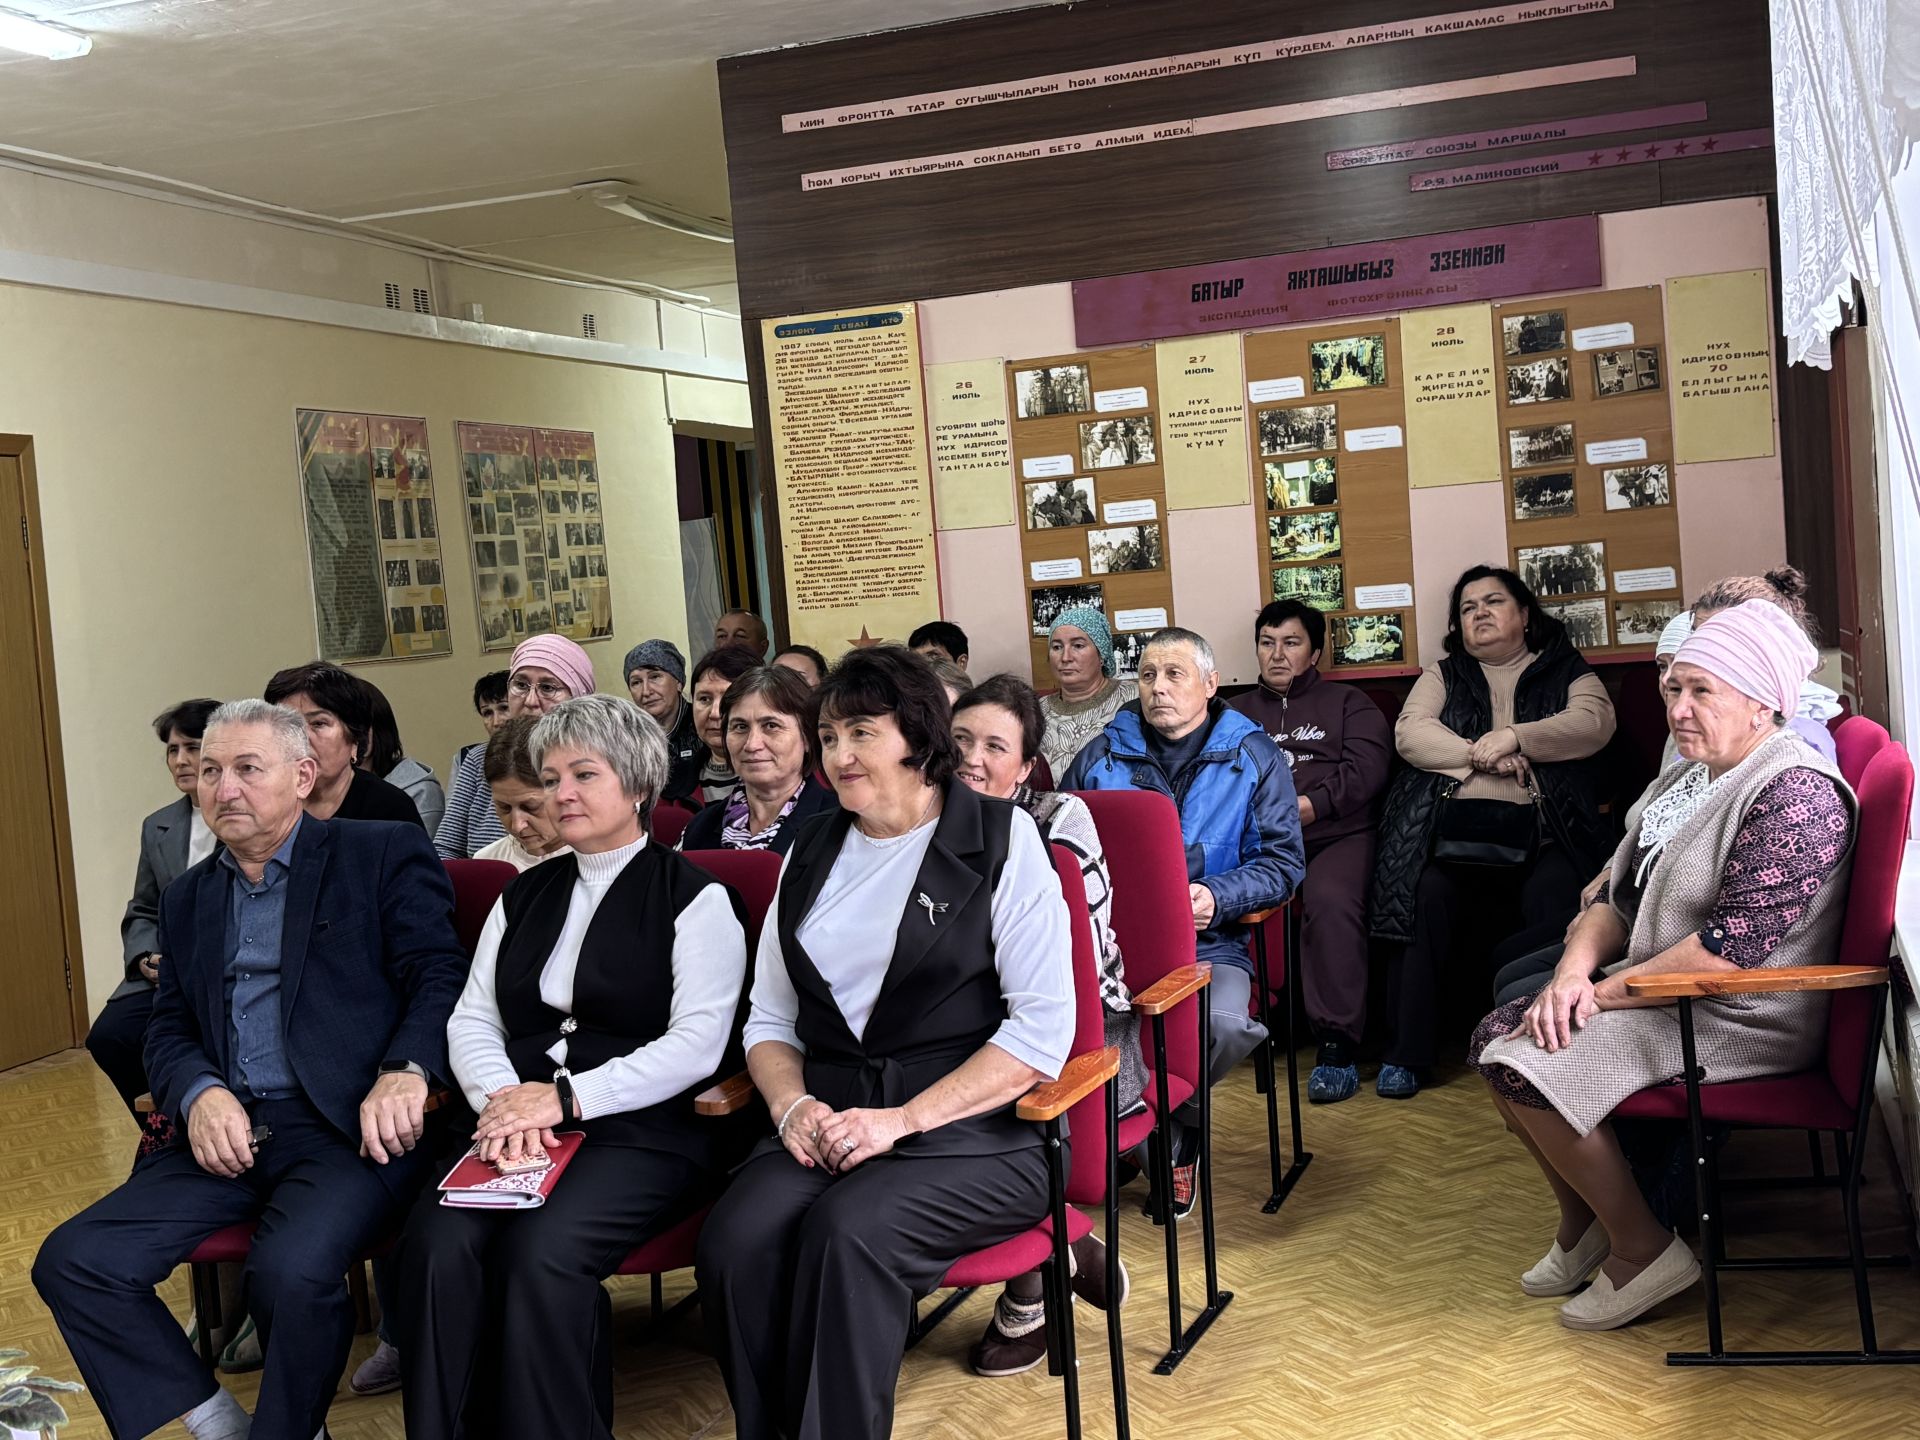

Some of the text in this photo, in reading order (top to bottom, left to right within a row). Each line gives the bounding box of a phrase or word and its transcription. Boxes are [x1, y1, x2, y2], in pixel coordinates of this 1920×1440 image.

[800, 118, 824, 129] МИН
[838, 108, 894, 123] ФРОНТТА
[907, 101, 945, 113] ТАТАР
[956, 84, 1058, 105] СУГЫШЧЫЛАРЫН
[1104, 58, 1221, 82] КОМАНДИРЛАРЫН
[1425, 14, 1504, 34] КАКШАМАС
[1518, 1, 1608, 20] НЫКЛЫГЫНА
[1426, 141, 1476, 155] СОЮЗЫ
[1488, 129, 1566, 146] МАРШАЛЫ
[841, 171, 880, 183] КОРЫЧ
[890, 159, 964, 177] ИХТЫЯРЫНА
[974, 148, 1040, 164] СОКЛАНЫП
[1095, 133, 1144, 147] АЛМЫЙ
[1452, 162, 1559, 183] МАЛИНОВСКИЙ
[1191, 278, 1244, 303] БАТЫР
[1288, 259, 1394, 291] ЯКТАШЫБЫЗ
[1199, 285, 1458, 322] ЭКСПЕДИЦИЯ ФОТОХРОНИКАСЫ
[1431, 338, 1464, 347] ИЮЛЬ
[1707, 342, 1730, 350] НУХ
[1189, 355, 1206, 363] 27
[1415, 368, 1489, 381] КАРЕЛИЯ
[1710, 364, 1727, 372] 70
[1682, 373, 1768, 386] ЕЛЛЫГЫНА
[1416, 390, 1491, 403] ОЧРАШУЛАР
[1683, 384, 1769, 397] БАГЫШЛАНА
[952, 431, 998, 439] УРАМЫНА
[964, 440, 1007, 448] ИДРИСОВ
[938, 453, 977, 461] ИСЕМЕН
[939, 461, 1009, 471] ТАНТАНАСЫ
[1290, 722, 1326, 740] Vibes
